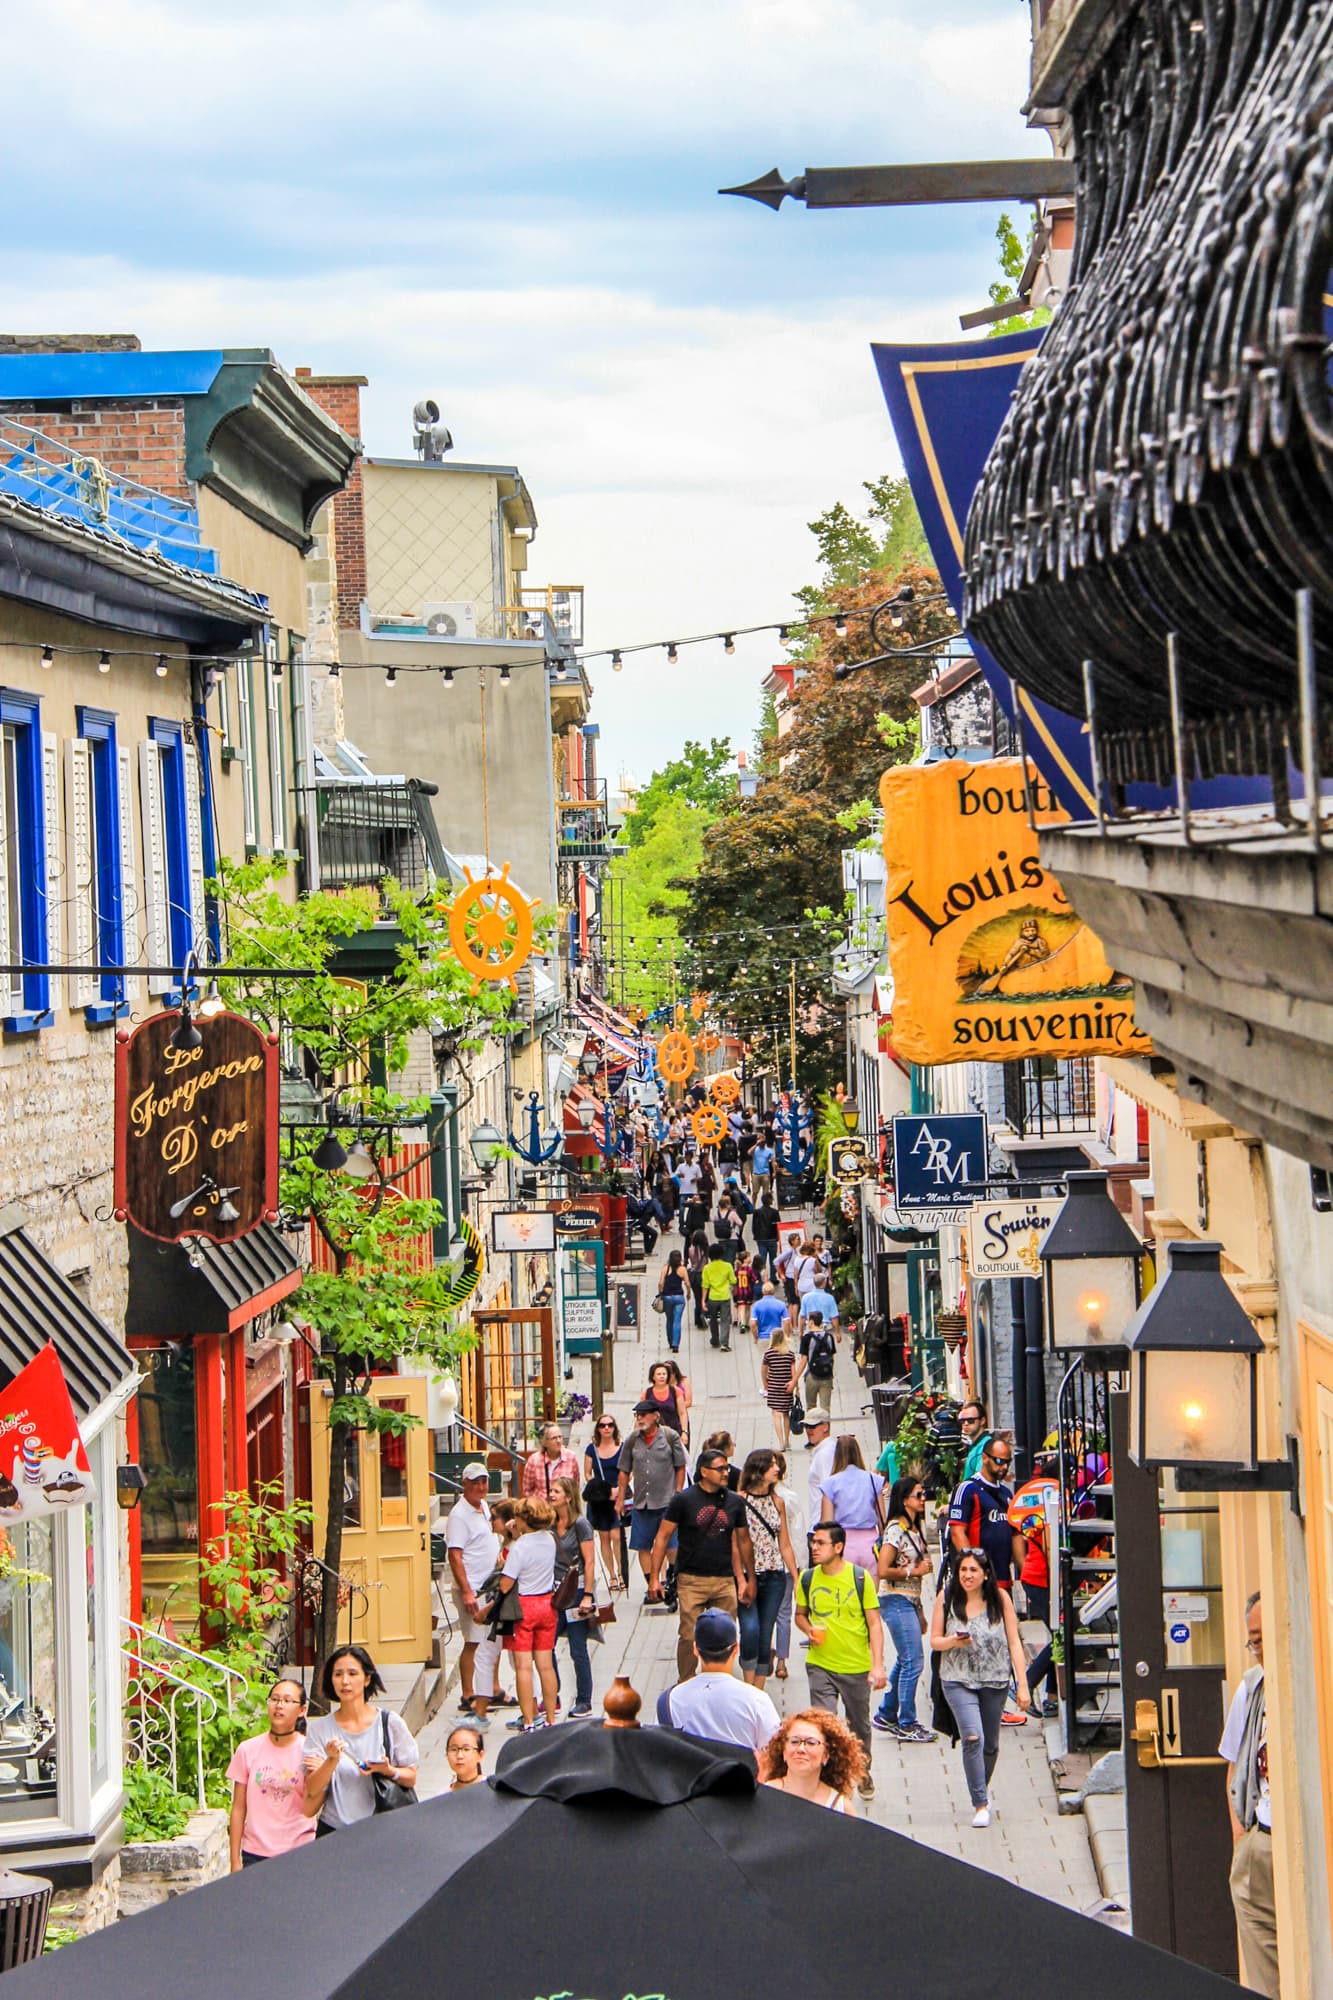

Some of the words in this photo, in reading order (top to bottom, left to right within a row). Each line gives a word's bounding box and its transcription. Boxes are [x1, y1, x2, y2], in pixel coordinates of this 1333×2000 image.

[889, 851, 1044, 946] Louis
[164, 1045, 204, 1075] Le
[130, 1054, 264, 1137] Forgeron
[952, 1191, 985, 1202] Boutique
[1026, 1205, 1038, 1214] LE
[977, 1263, 1021, 1273] BOUTIQUE
[737, 1273, 748, 1288] 10
[1173, 1629, 1187, 1638] ADT
